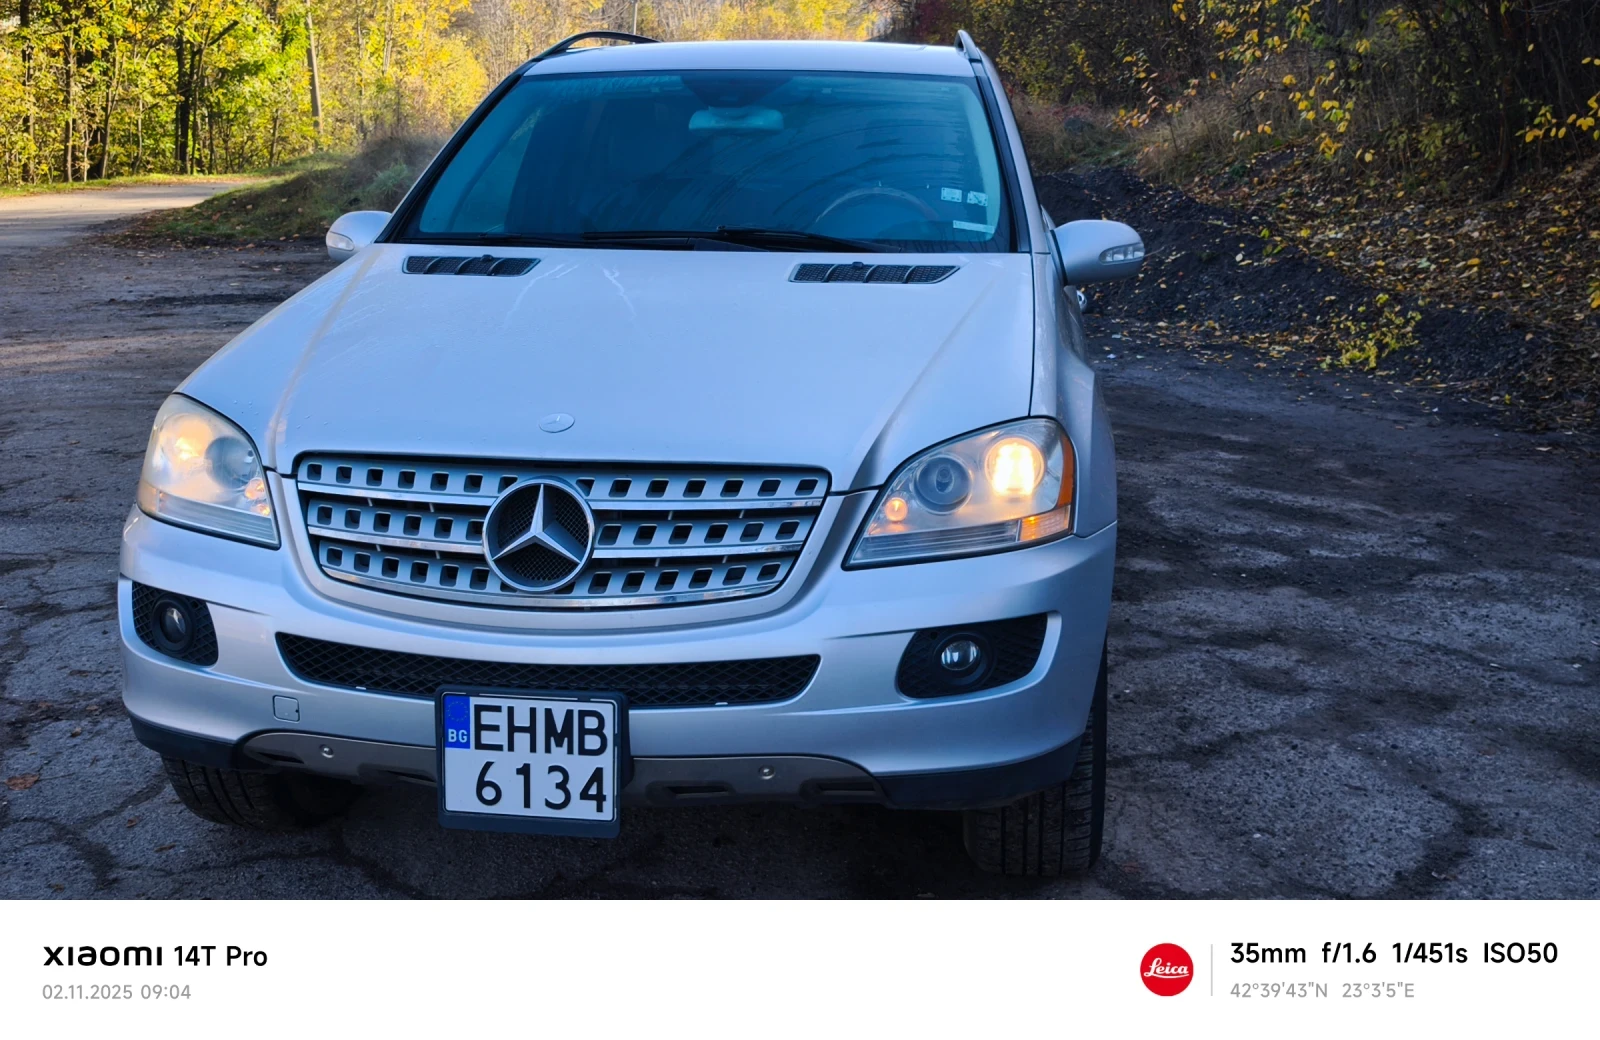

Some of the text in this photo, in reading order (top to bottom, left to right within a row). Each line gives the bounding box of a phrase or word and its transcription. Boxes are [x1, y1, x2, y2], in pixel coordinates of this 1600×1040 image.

[447, 728, 468, 743] BG
[474, 703, 608, 756] EHMB
[475, 760, 607, 813] 6134
